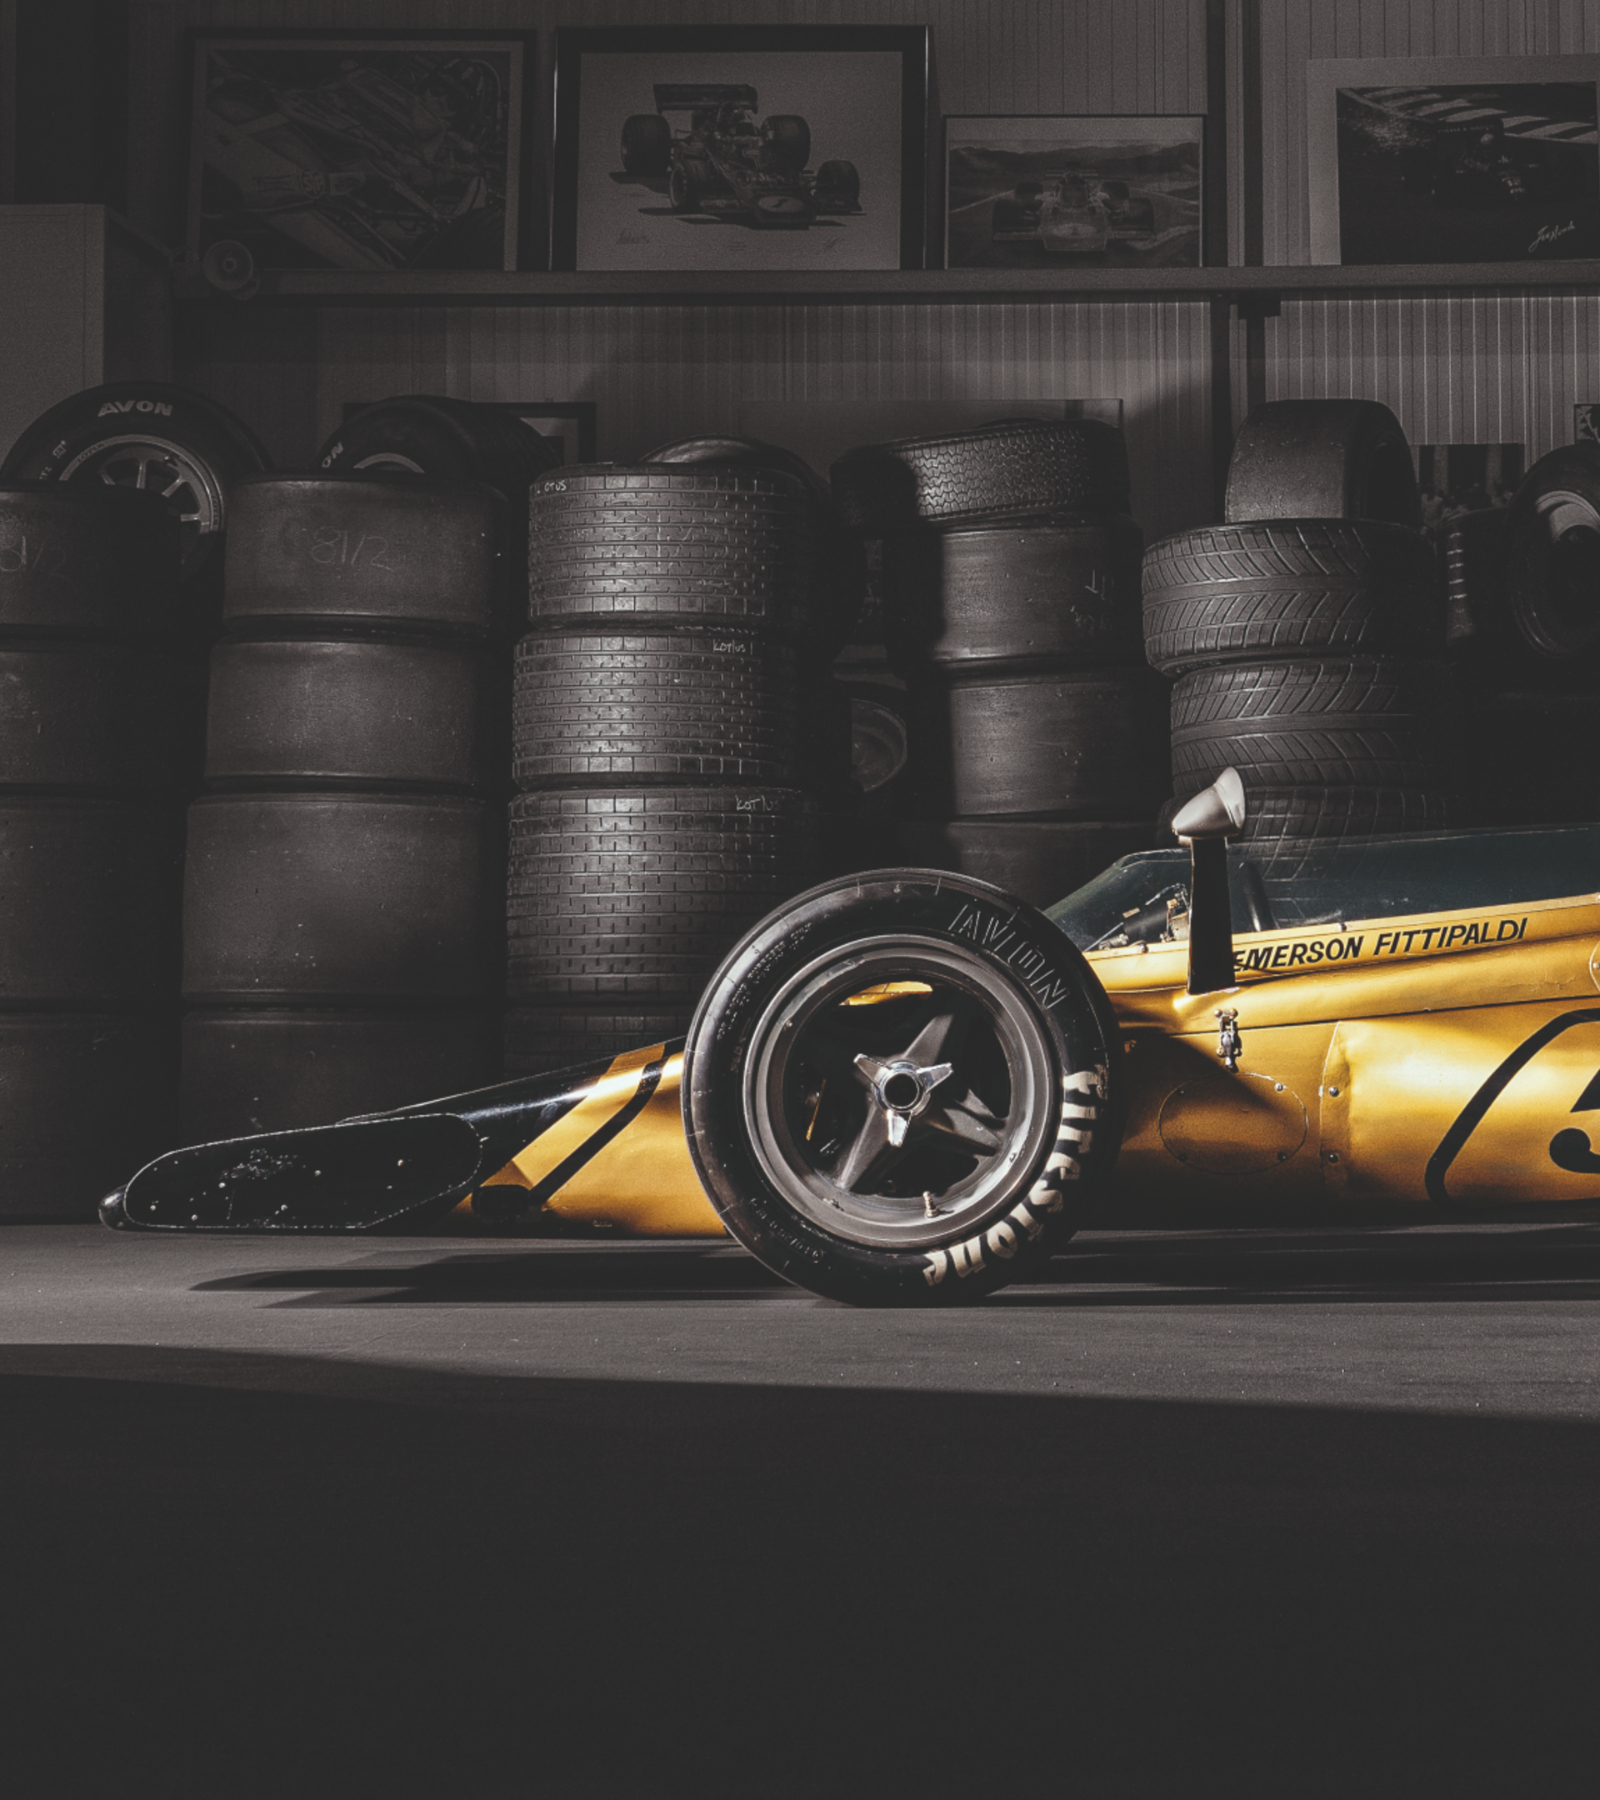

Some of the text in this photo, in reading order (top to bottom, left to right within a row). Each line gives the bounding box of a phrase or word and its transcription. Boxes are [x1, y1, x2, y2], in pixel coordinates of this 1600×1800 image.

[97, 399, 174, 418] AVON
[320, 441, 345, 469] ON
[948, 904, 1071, 1010] AVON
[1234, 917, 1528, 972] EMERSON FITTIPALDI
[922, 1063, 1108, 1287] Firestone
